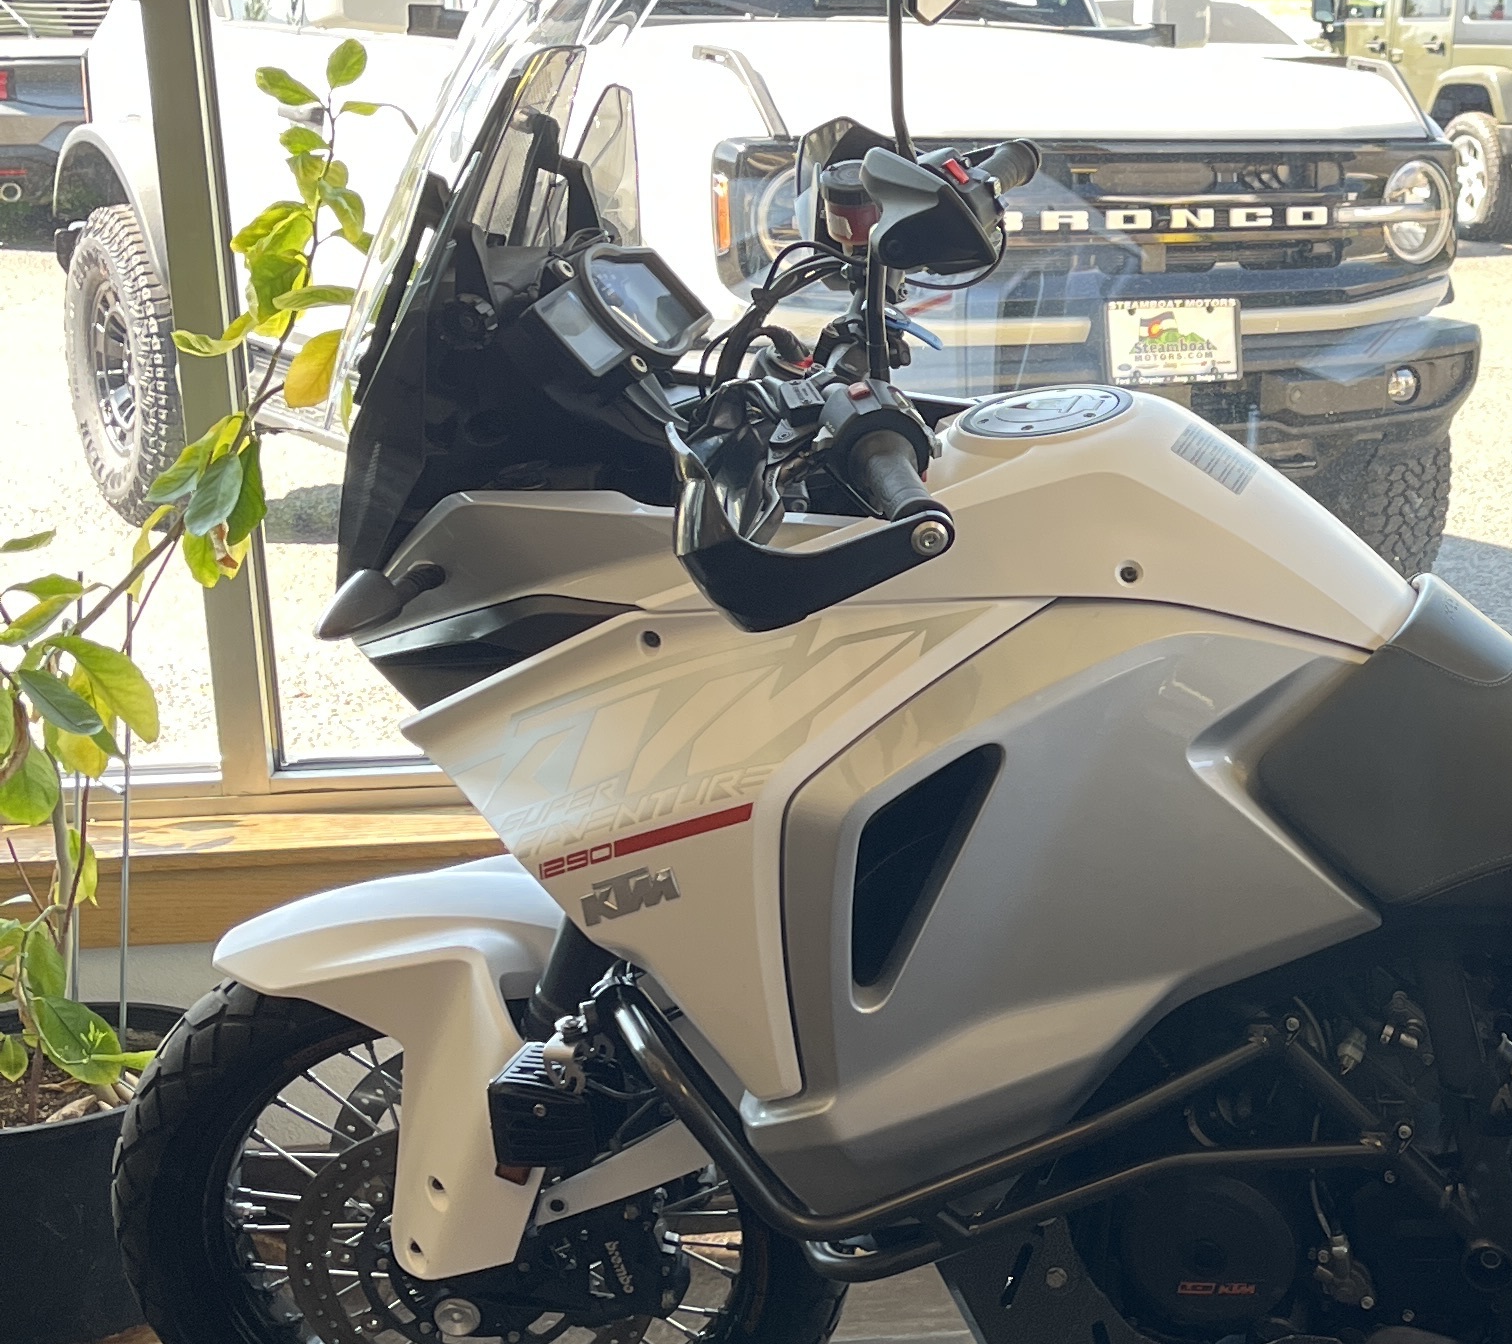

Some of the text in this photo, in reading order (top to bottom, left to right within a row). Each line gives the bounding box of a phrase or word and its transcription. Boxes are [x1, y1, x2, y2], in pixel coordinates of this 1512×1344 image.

[1108, 298, 1236, 309] STEAMBOAT MOTORS
[1134, 338, 1212, 353] Steamboat
[1134, 352, 1213, 361] MOTORS.COM
[500, 774, 622, 834] SUPER
[538, 843, 612, 880] 1290
[580, 867, 681, 926] KTM
[604, 1240, 635, 1294] brembo
